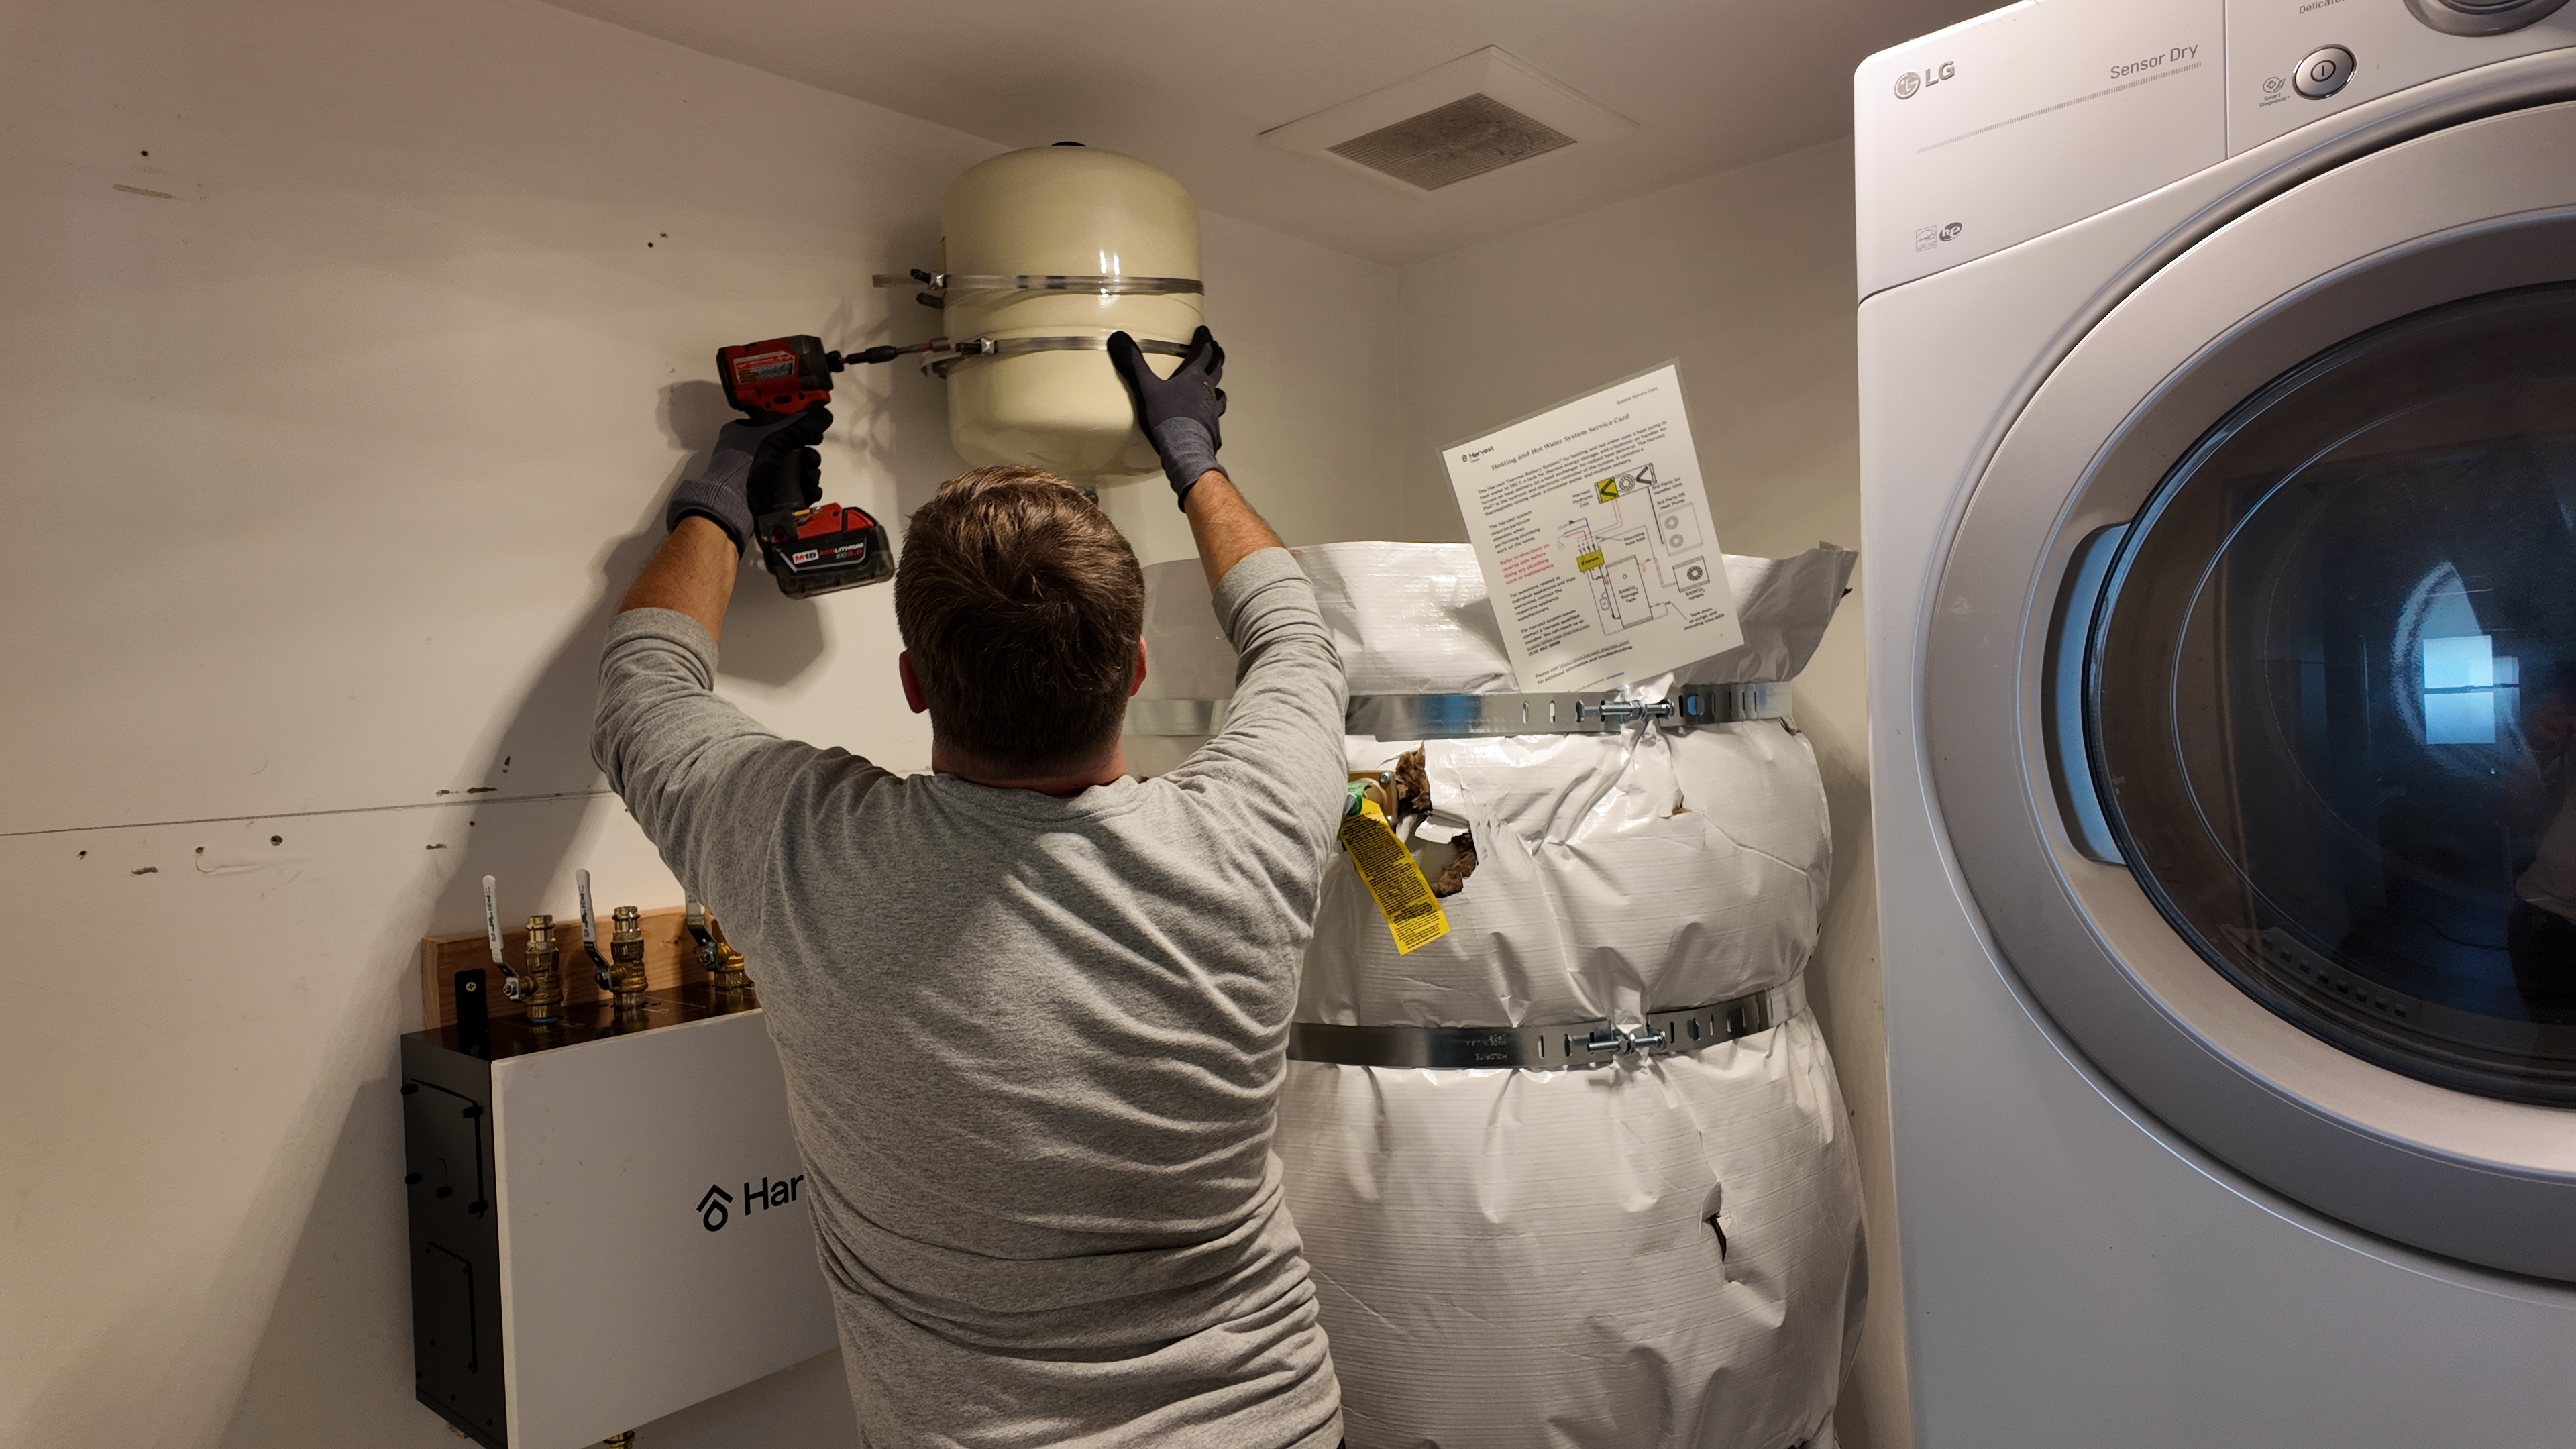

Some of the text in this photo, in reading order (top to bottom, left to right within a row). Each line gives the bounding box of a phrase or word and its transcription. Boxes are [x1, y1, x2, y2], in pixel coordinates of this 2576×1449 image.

[2299, 0, 2345, 14] Delicat
[1925, 60, 1955, 87] LG
[2110, 44, 2198, 79] Sensor Dry
[2264, 93, 2281, 101] Smart
[1468, 445, 1494, 459] Harvest
[1491, 413, 1630, 470] Heating and Hot Water System Service Card
[744, 1175, 804, 1216] Har
